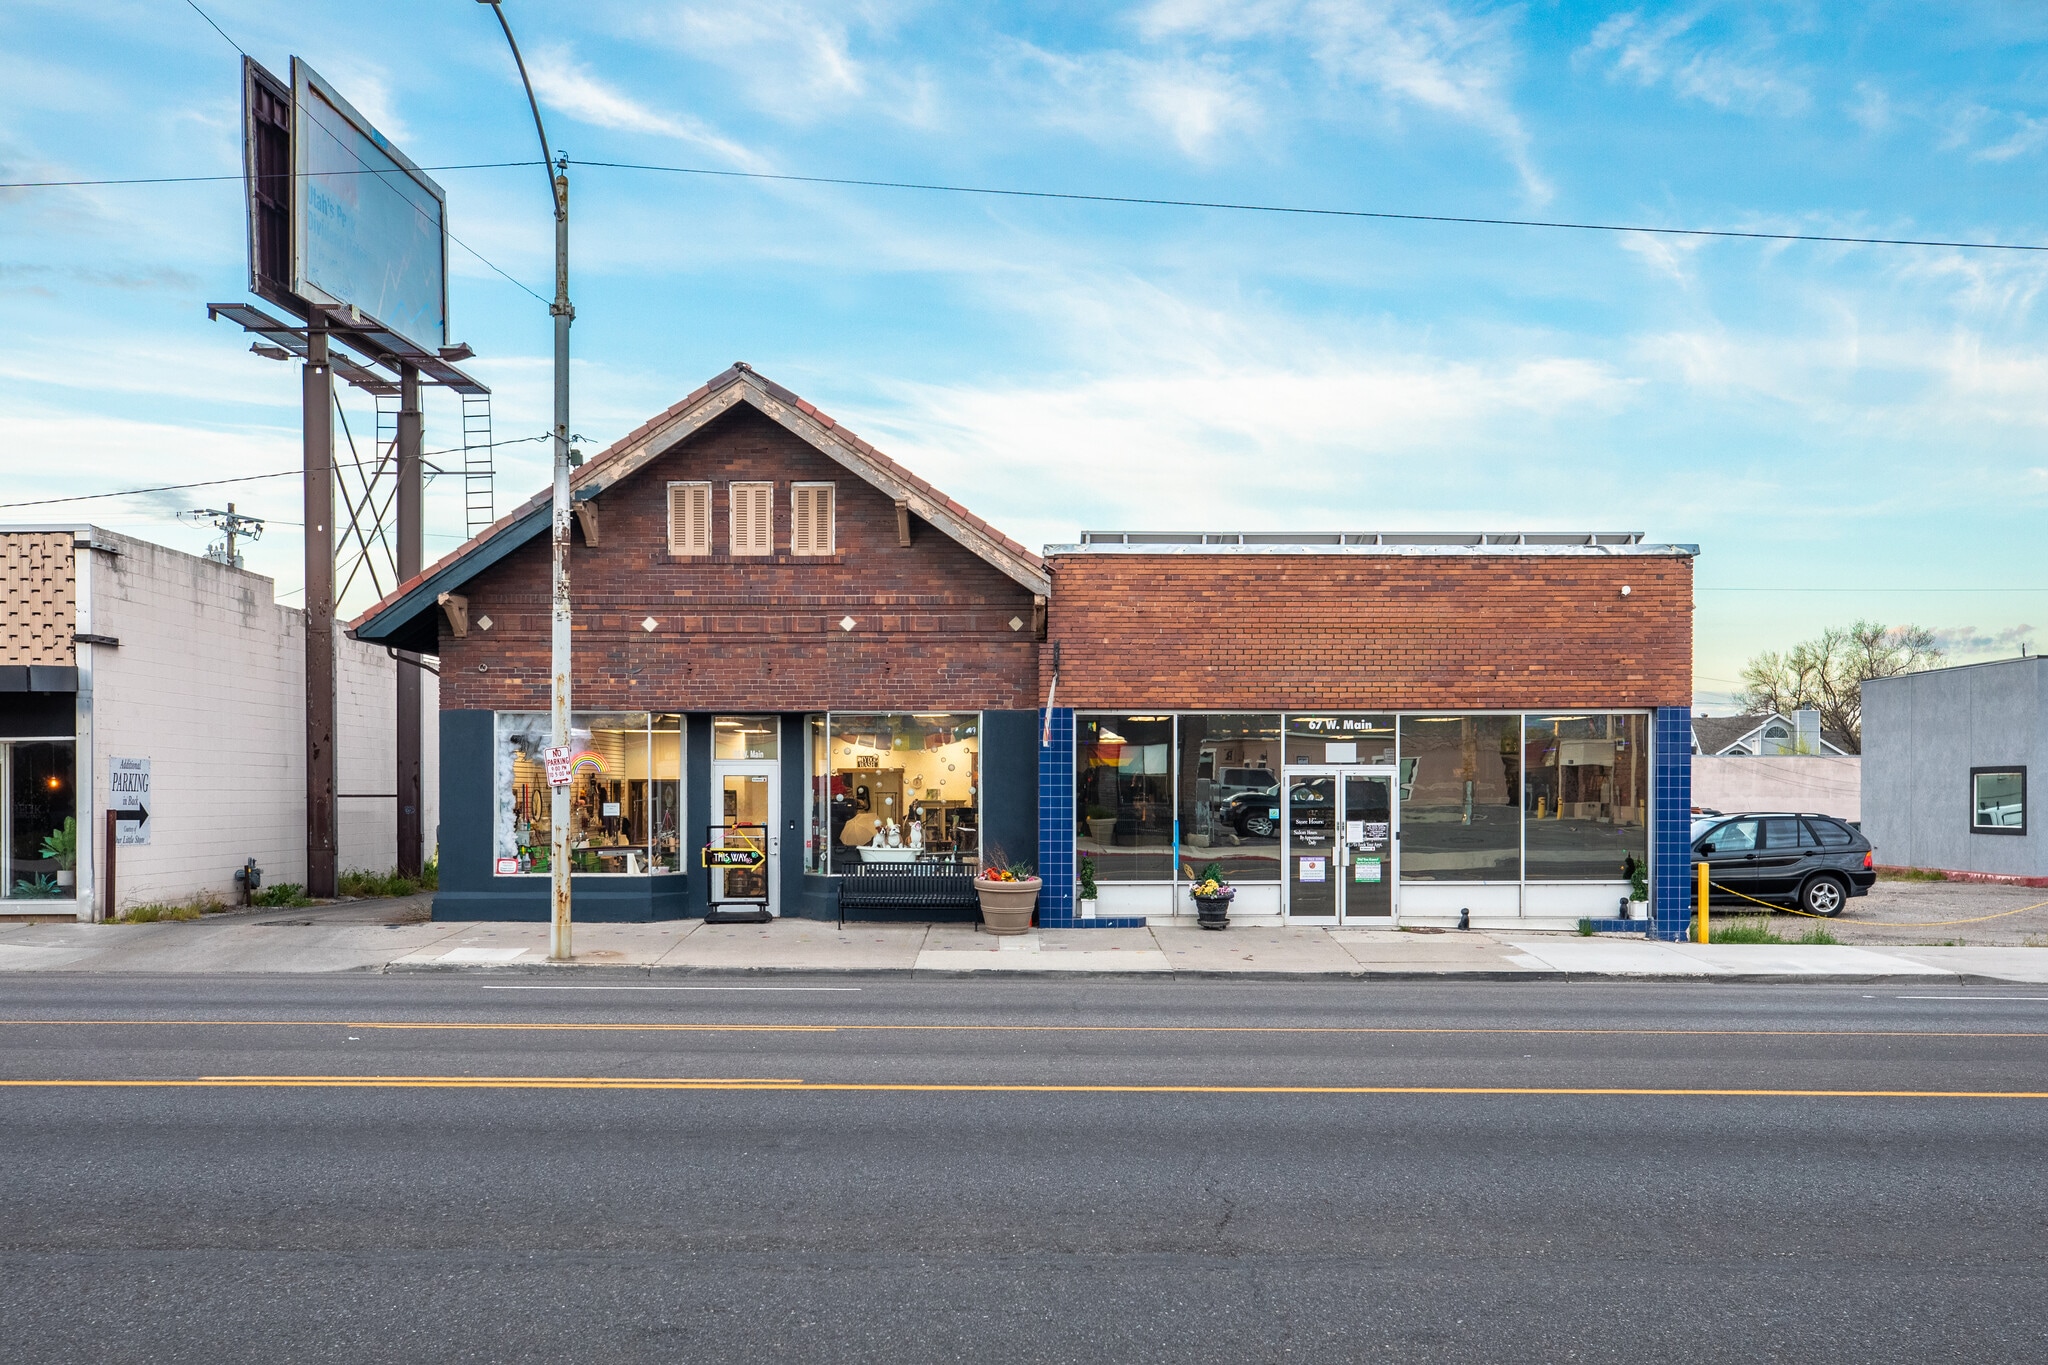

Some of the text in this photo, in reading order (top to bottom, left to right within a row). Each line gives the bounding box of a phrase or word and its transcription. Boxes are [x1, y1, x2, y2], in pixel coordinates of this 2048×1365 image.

[1308, 719, 1373, 730] 67 W. Main
[552, 749, 562, 757] NO
[750, 750, 764, 758] Main
[119, 759, 142, 769] Additional
[547, 757, 570, 766] PARKING
[112, 772, 149, 792] PARKING
[122, 795, 139, 806] in Back
[122, 835, 134, 844] Little
[713, 852, 748, 862] THIS WAY
